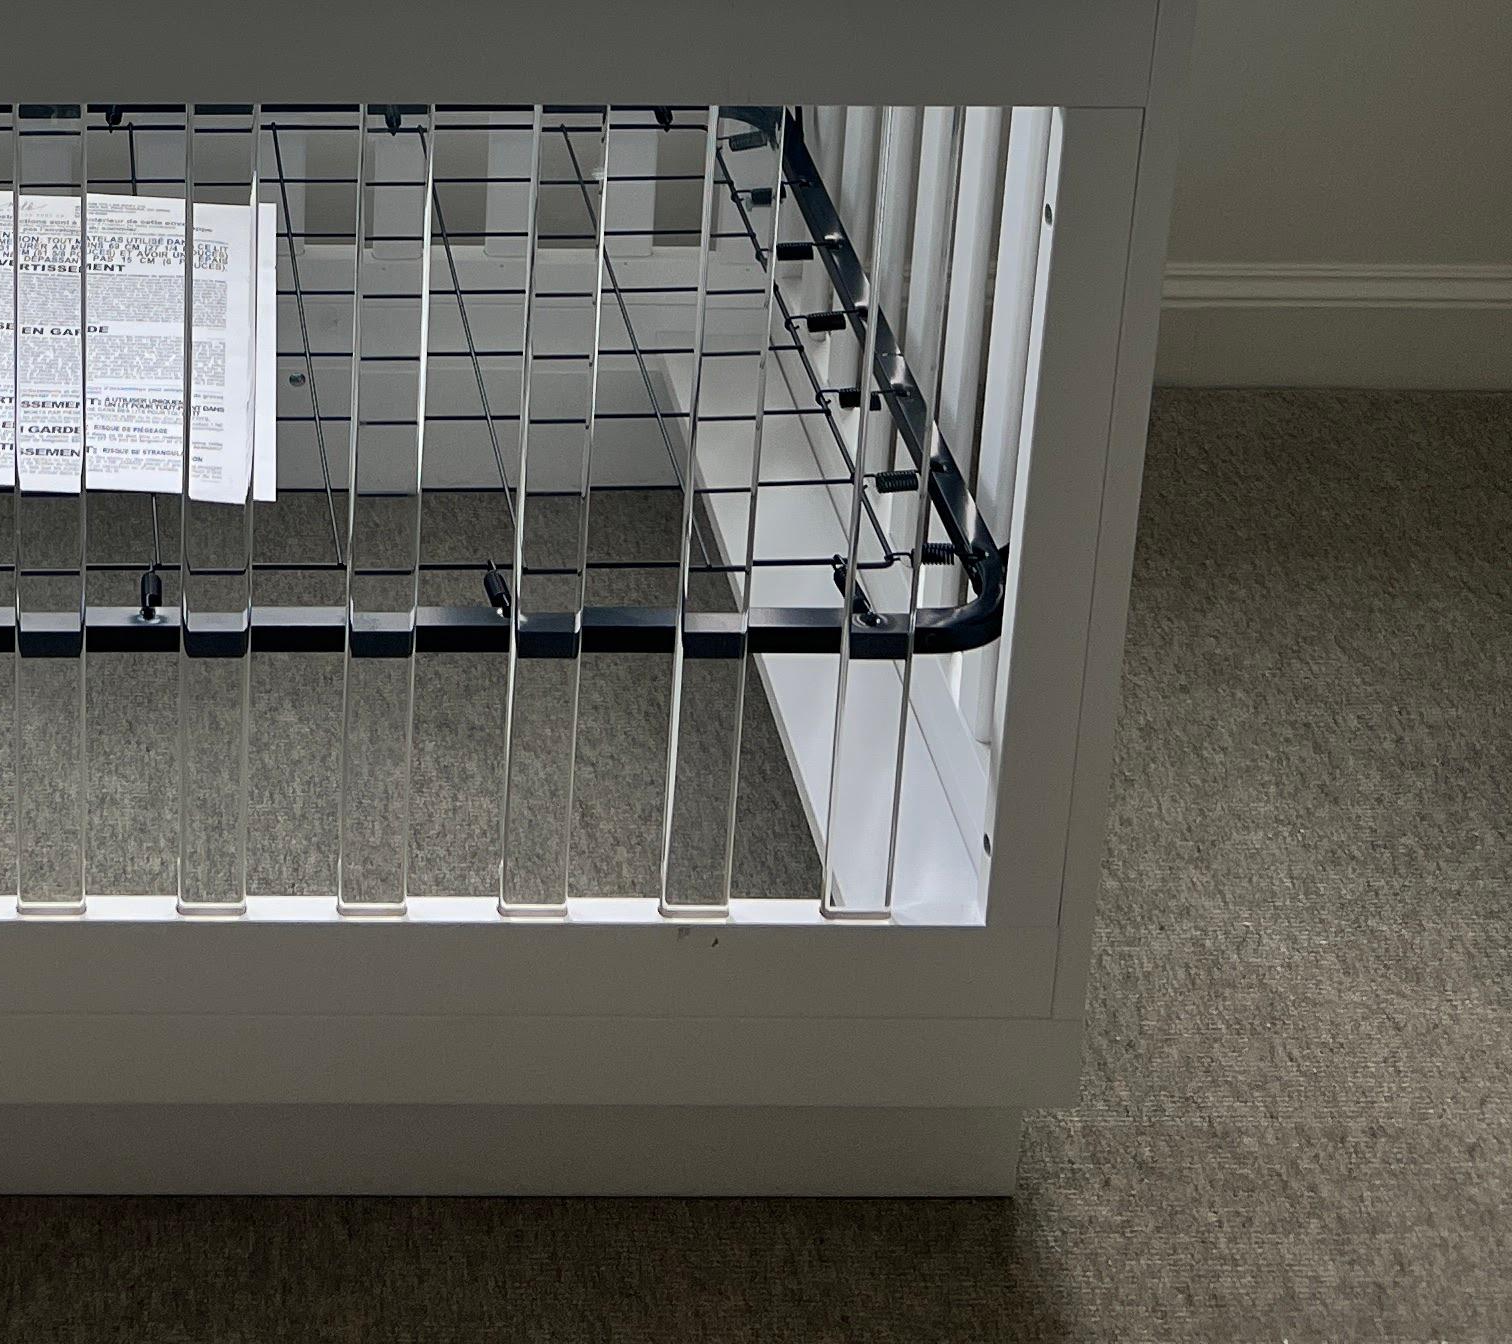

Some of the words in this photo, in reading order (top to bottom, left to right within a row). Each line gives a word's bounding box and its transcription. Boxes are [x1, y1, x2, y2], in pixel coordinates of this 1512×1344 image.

[24, 255, 79, 264] DÉPASSAN
[21, 326, 45, 335] EN
[50, 325, 109, 336] GARDE
